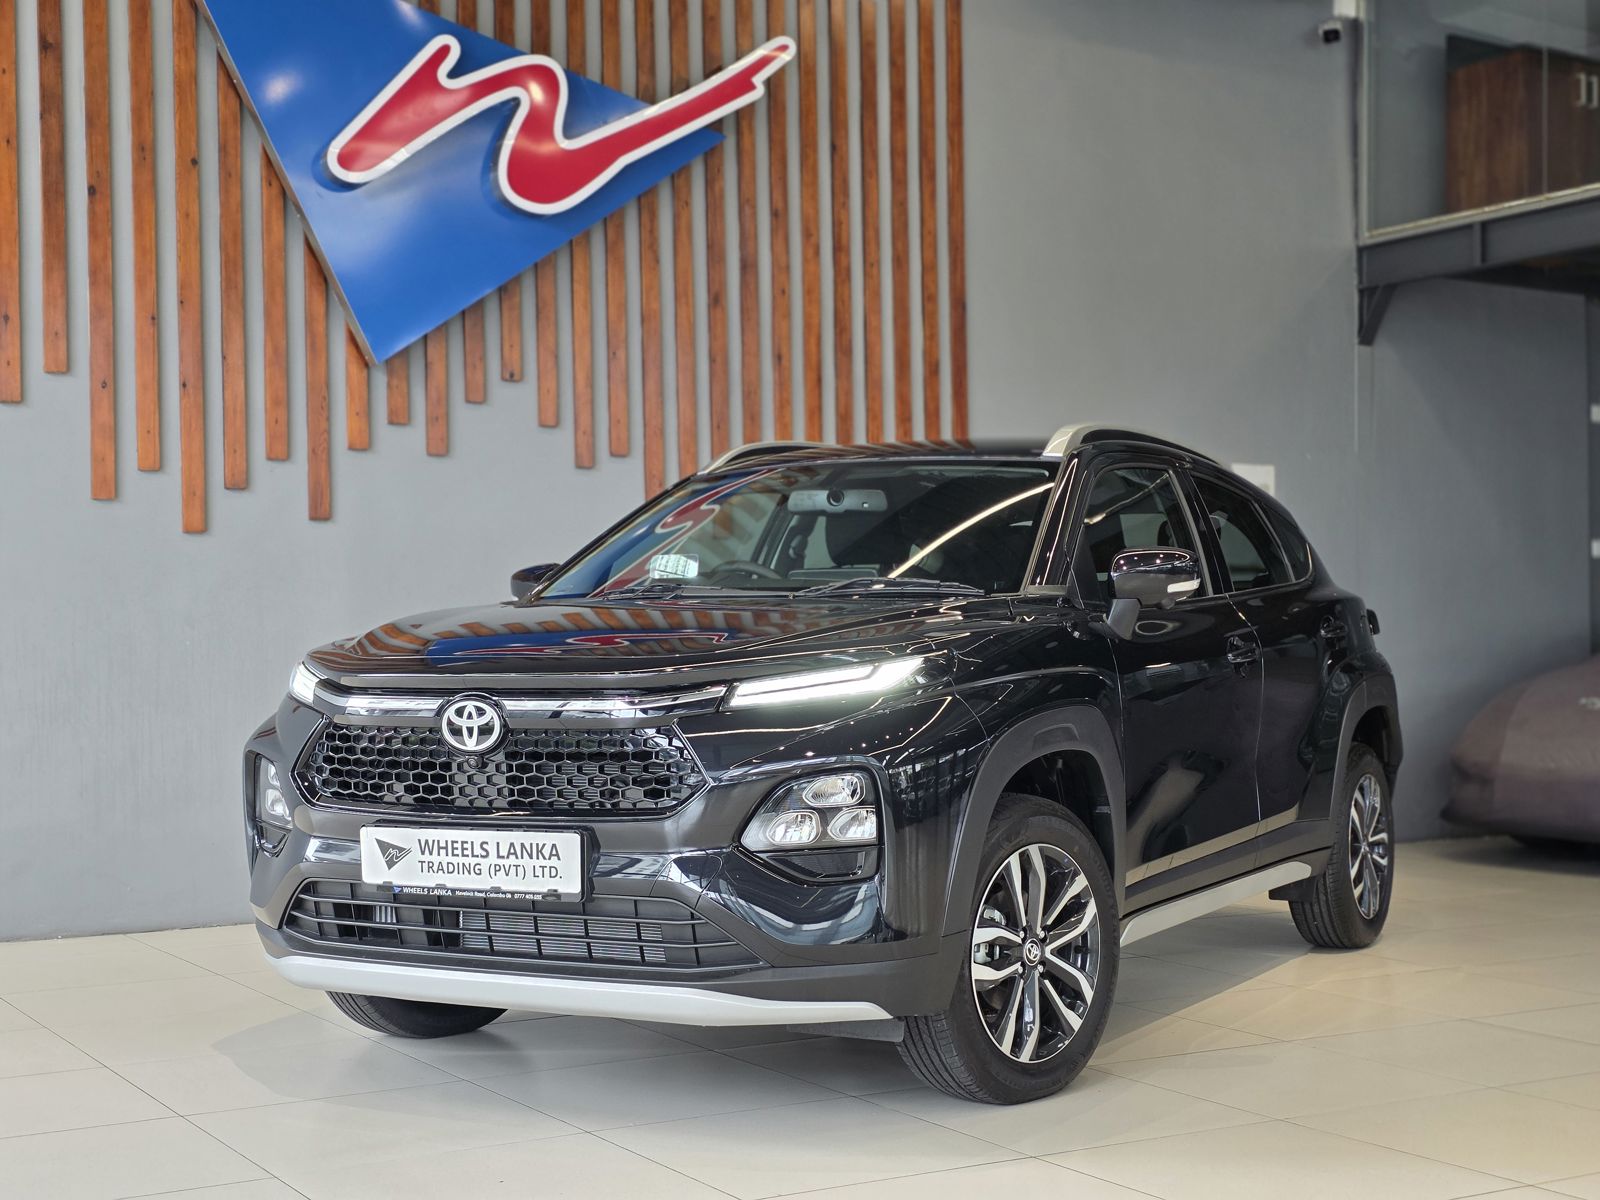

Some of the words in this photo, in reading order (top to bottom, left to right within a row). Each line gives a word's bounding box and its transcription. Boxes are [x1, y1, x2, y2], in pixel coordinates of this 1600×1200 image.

[417, 838, 490, 859] WHEELS
[496, 841, 562, 861] LANKA
[417, 860, 483, 876] TRADING
[488, 863, 527, 880] (PVT)
[532, 865, 563, 879] LTD.
[402, 886, 428, 895] WHEELS
[430, 888, 452, 896] LANKA
